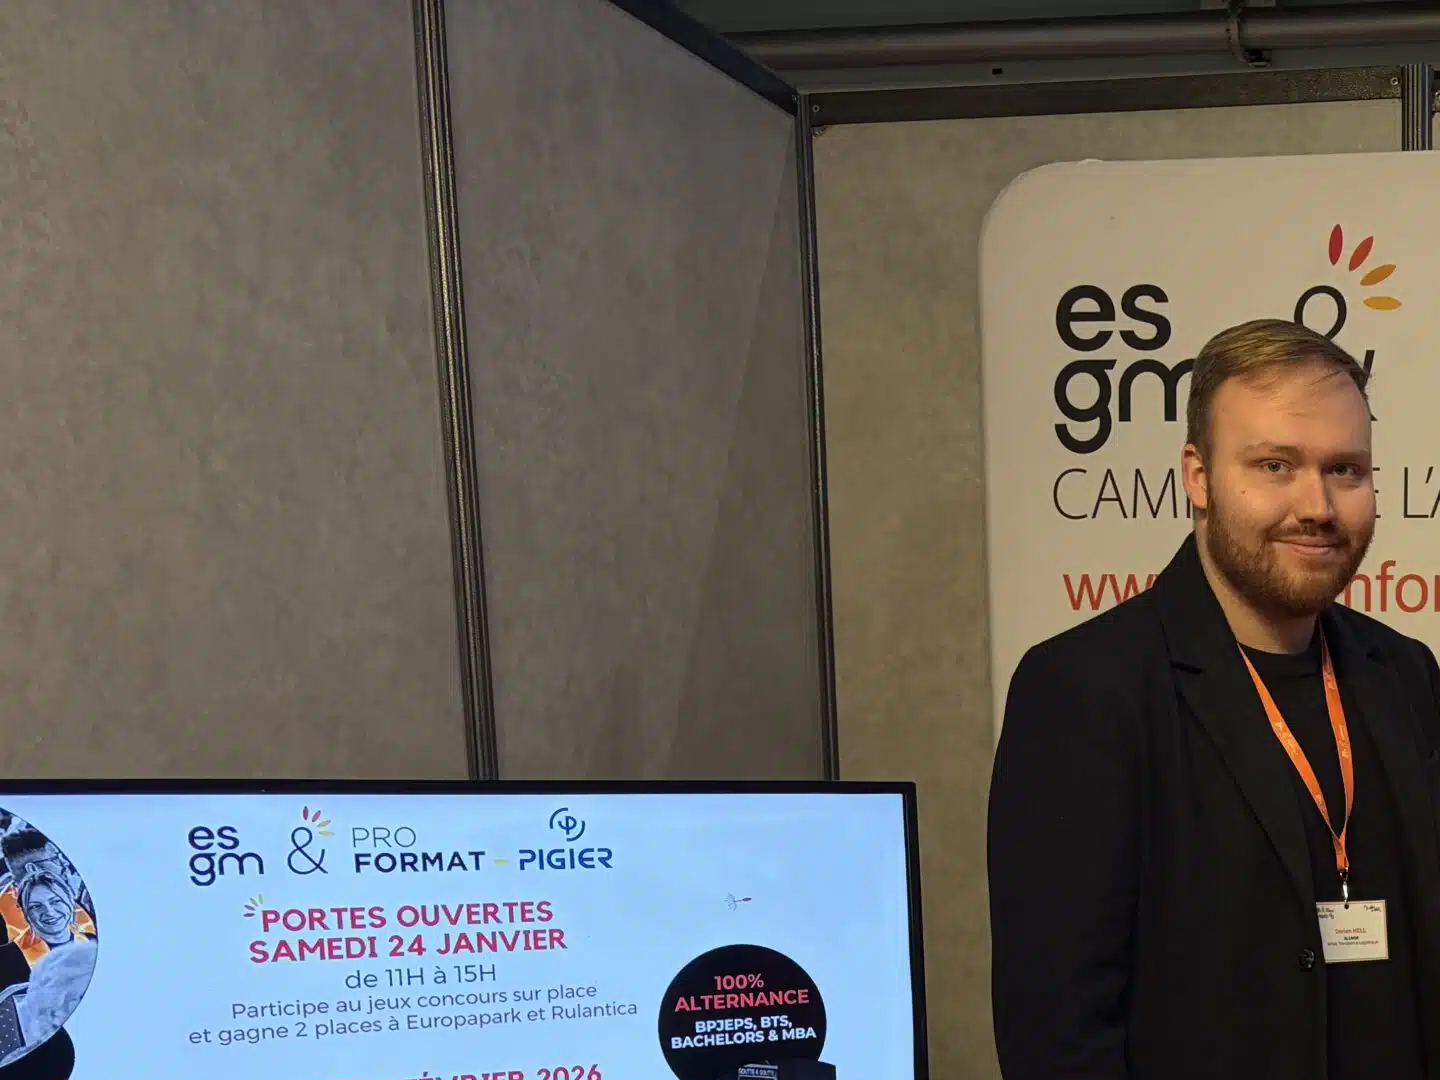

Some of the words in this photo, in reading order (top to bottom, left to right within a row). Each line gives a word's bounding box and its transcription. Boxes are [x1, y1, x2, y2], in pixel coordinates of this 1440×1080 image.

[1055, 283, 1172, 352] es
[188, 826, 240, 850] es
[352, 826, 416, 848] PRO
[189, 852, 264, 886] gm
[354, 850, 486, 873] FORMAT
[519, 848, 613, 870] PIGIER
[262, 906, 386, 933] PORTES
[397, 901, 553, 926] OUVERTES
[249, 936, 377, 964] SAMEDI
[388, 934, 426, 957] 24
[436, 929, 567, 955] JANVIER
[345, 970, 378, 989] de
[385, 967, 425, 987] 11H
[433, 965, 448, 985] à
[454, 963, 497, 983] 15H
[714, 973, 764, 991] 100%
[231, 998, 329, 1020] Participe
[336, 999, 362, 1014] au
[367, 994, 412, 1015] jeux
[417, 989, 508, 1008] concours
[513, 987, 543, 1002] sur
[547, 983, 598, 1004] place
[674, 988, 810, 1012] ALTERNANCE
[188, 1026, 213, 1045] et
[218, 1025, 290, 1046] gagne
[295, 1022, 309, 1038] 2
[315, 1016, 383, 1040] places
[388, 1013, 401, 1031] à
[407, 1006, 521, 1033] Europapark
[527, 1004, 546, 1022] et
[551, 999, 638, 1020] Rulantica
[695, 1016, 757, 1034] BPJEPS,
[761, 1014, 793, 1031] BTS,
[671, 1031, 765, 1049] BACHELORS
[768, 1028, 779, 1042] &
[782, 1026, 817, 1041] MBA
